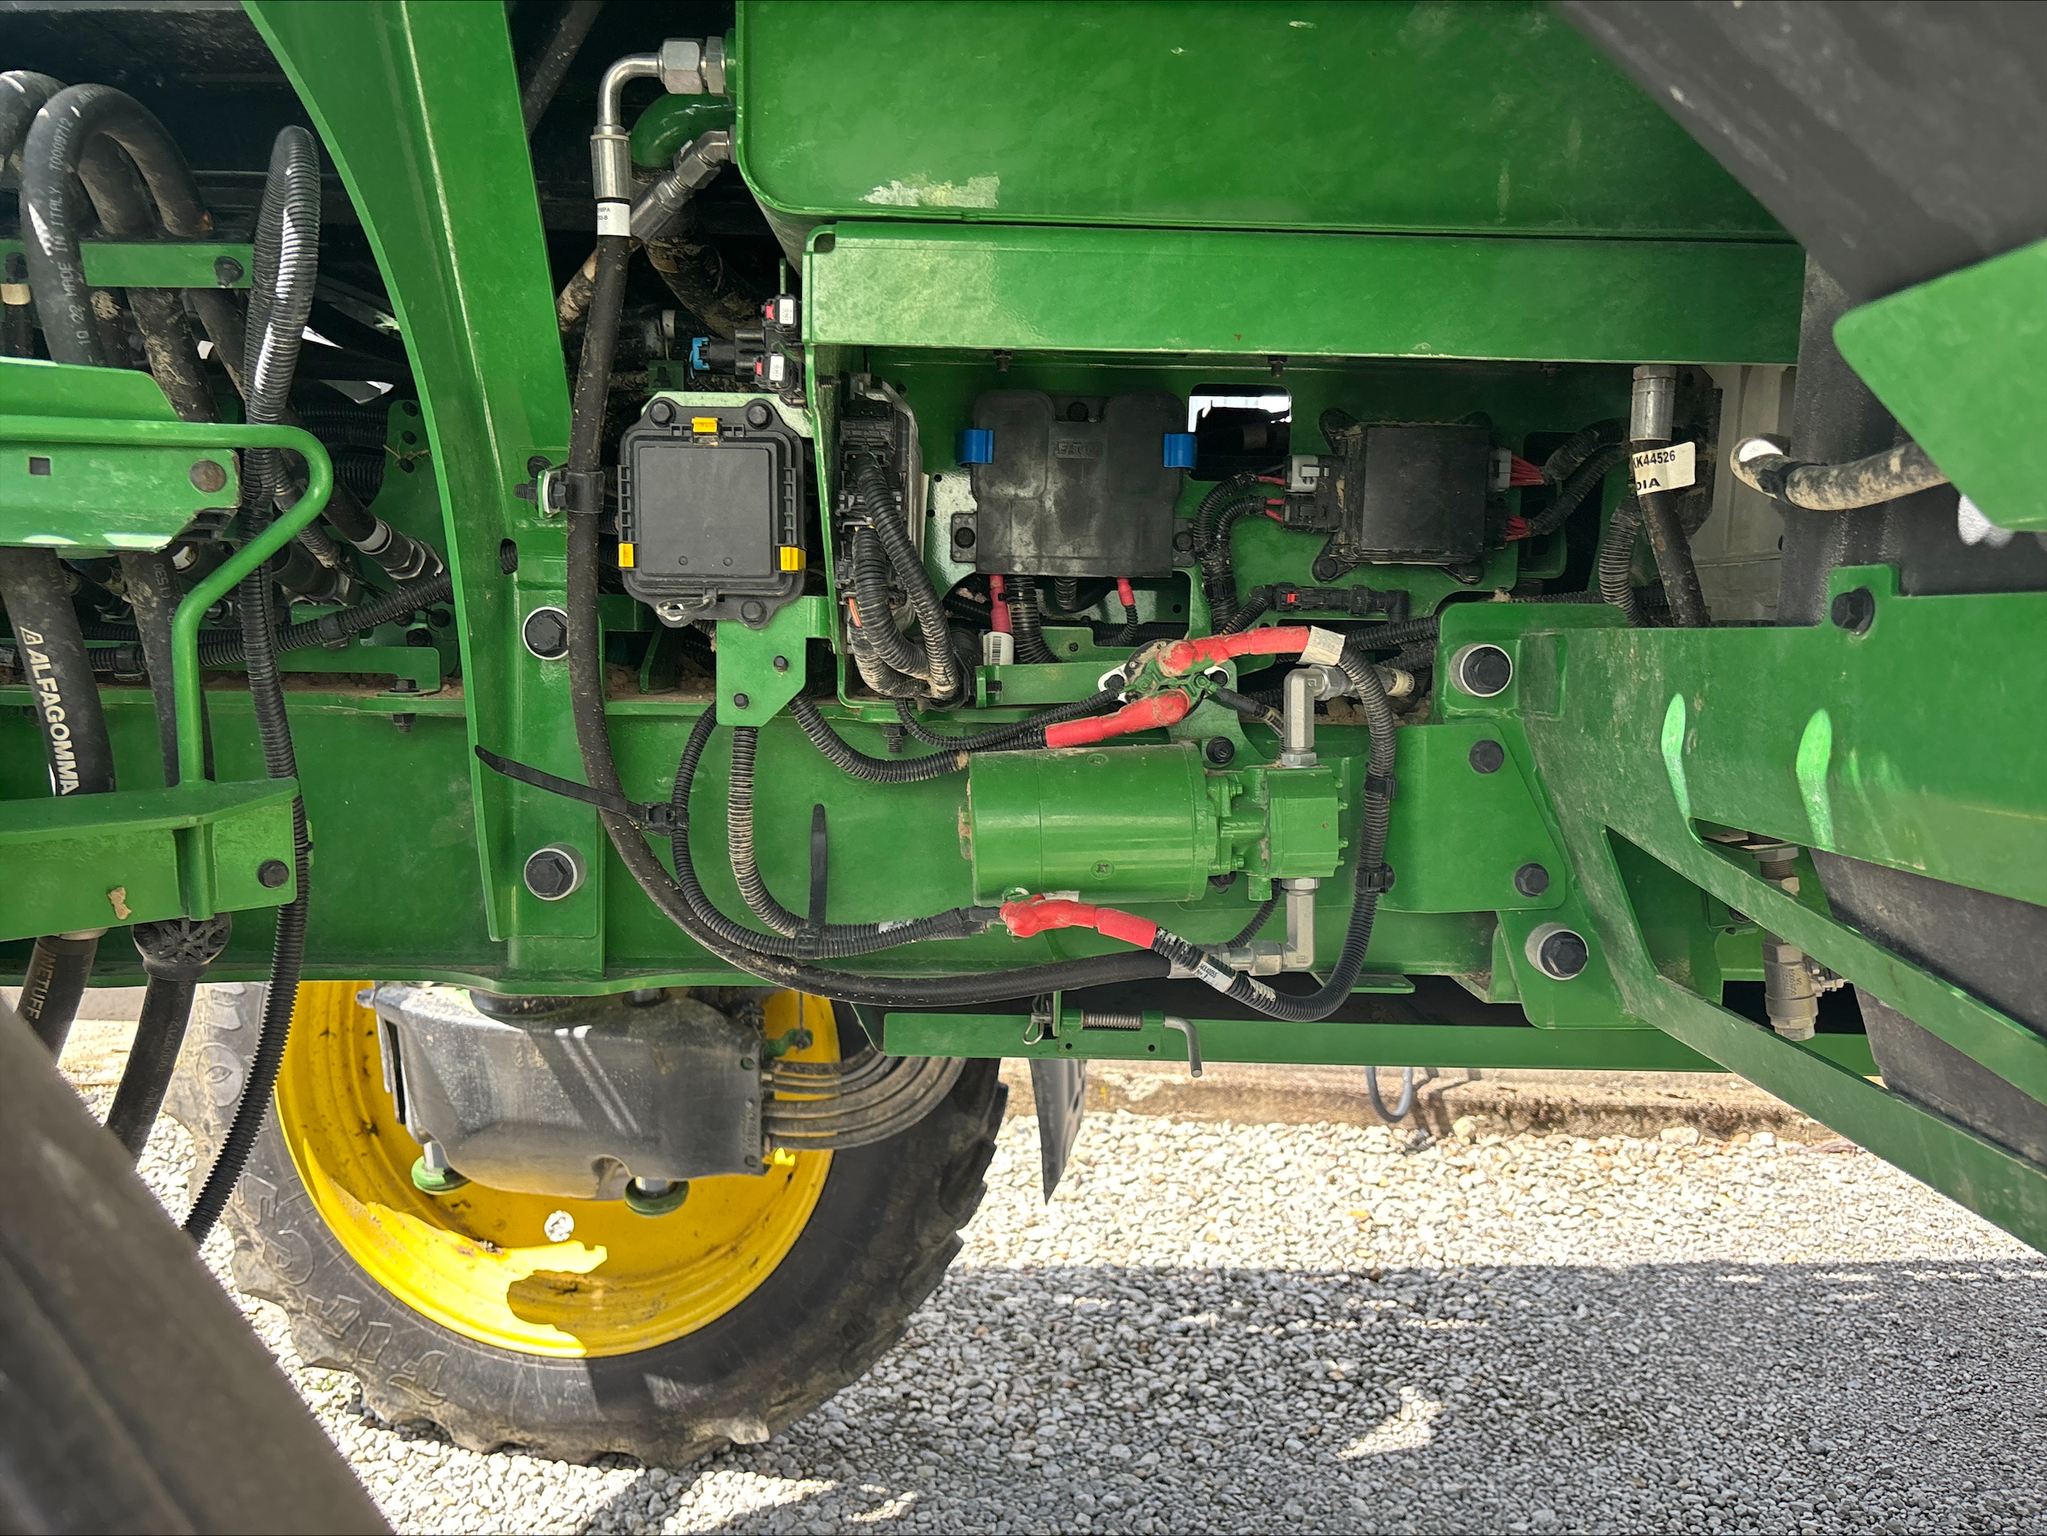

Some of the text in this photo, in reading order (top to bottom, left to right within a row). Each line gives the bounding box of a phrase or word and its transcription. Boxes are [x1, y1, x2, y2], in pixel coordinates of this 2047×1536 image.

[48, 186, 66, 227] ITALY
[52, 236, 69, 254] IN
[57, 262, 78, 297] MADE
[27, 648, 80, 795] ALFAGOMMA
